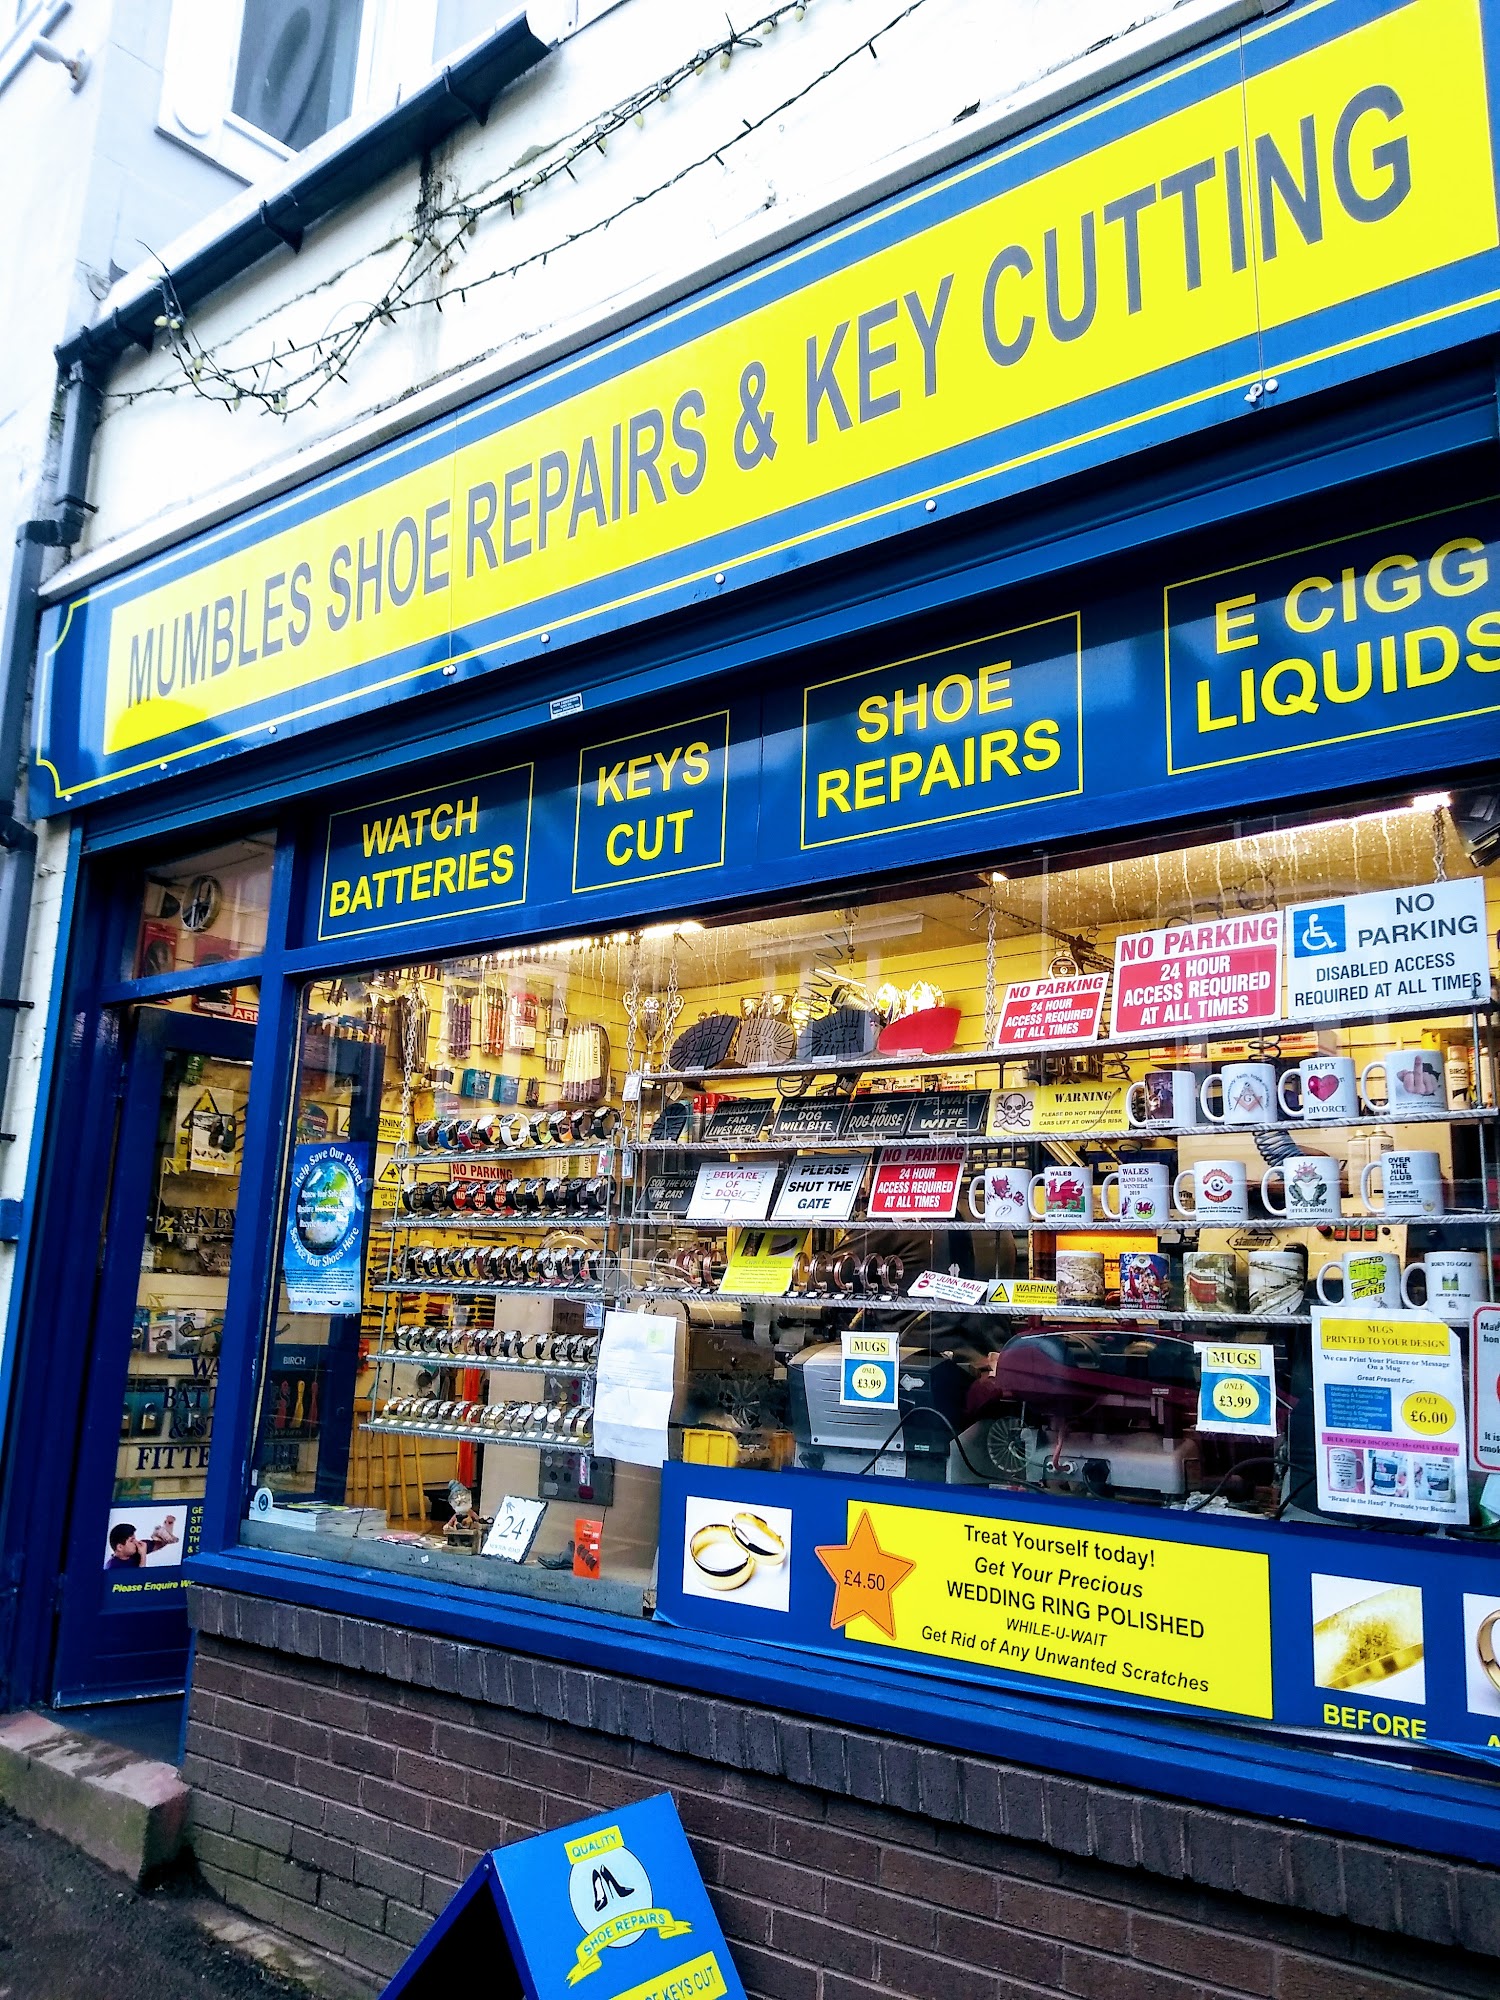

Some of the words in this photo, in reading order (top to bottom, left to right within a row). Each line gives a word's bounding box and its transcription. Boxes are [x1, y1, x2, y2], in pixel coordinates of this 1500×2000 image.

[128, 562, 312, 708] MUMBLES
[327, 500, 451, 633] SHOE
[466, 389, 707, 578] REPAIRS
[734, 361, 778, 471] &
[805, 273, 955, 445] KEY
[982, 84, 1412, 366] CUTTING
[1215, 594, 1259, 654] E
[1284, 538, 1489, 633] CIGG
[1196, 611, 1500, 733] LIQUIDS
[856, 660, 1012, 743] SHOE
[597, 742, 710, 806] KEYS
[817, 720, 1061, 818] REPAIRS
[363, 796, 479, 857] WATCH
[606, 810, 693, 866] CUT
[329, 844, 514, 917] BATTERIES
[1396, 893, 1434, 915] NO
[1120, 938, 1153, 962] NO
[1165, 917, 1278, 957] PARKING
[1358, 915, 1478, 947] PARKING
[1160, 963, 1180, 981] 24
[1186, 956, 1230, 978] HOUR
[1316, 961, 1388, 982] DISABLED
[1394, 952, 1455, 972] ACCESS
[1008, 986, 1030, 999] NO
[1036, 976, 1104, 996] PARKING
[1124, 982, 1182, 1007] ACCESS
[1188, 970, 1270, 1000] REQUIRED
[1295, 986, 1368, 1006] REQUIRED
[1374, 983, 1392, 998] AT
[1398, 979, 1426, 995] ALL
[1432, 972, 1481, 991] TIMES
[1030, 1002, 1042, 1012] 24
[1046, 998, 1072, 1010] HOUR
[1140, 1007, 1160, 1026] AT
[1166, 1003, 1192, 1022] ALL
[1197, 994, 1249, 1018] TIMES
[1006, 1013, 1042, 1026] ACCESS
[1045, 1008, 1094, 1022] REQUIRED
[1014, 1029, 1026, 1039] AT
[1028, 1026, 1046, 1037] ALL
[1049, 1022, 1079, 1035] TIMES
[1308, 1063, 1337, 1071] HAPPY
[1055, 1091, 1112, 1103] WARNING
[798, 1112, 822, 1120] DOG
[1308, 1106, 1347, 1114] DIVORCE
[726, 1116, 748, 1124] FAN
[780, 1122, 805, 1131] WILL
[807, 1121, 833, 1130] BITE
[872, 1114, 904, 1126] HOUSE
[920, 1118, 968, 1129] WIFE
[709, 1126, 731, 1135] LIVES
[734, 1124, 757, 1134] HERE
[882, 1149, 900, 1162] NO
[905, 1146, 964, 1161] PARKING
[294, 1164, 310, 1188] Help
[309, 1150, 327, 1165] Save
[329, 1147, 344, 1160] Our
[344, 1154, 363, 1186] Planet
[452, 1164, 467, 1176] NO
[470, 1166, 513, 1180] PARKING
[713, 1171, 759, 1179] BEWARE
[801, 1164, 850, 1176] PLEASE
[899, 1169, 910, 1180] 24
[912, 1168, 936, 1179] HOUR
[651, 1190, 664, 1198] THE
[665, 1190, 684, 1198] CATS
[788, 1181, 823, 1192] SHUT
[828, 1181, 853, 1192] THE
[877, 1181, 910, 1194] ACCESS
[912, 1181, 953, 1193] REQUIRED
[655, 1201, 670, 1209] EVIL
[797, 1198, 832, 1209] GATE
[884, 1195, 896, 1208] AT
[898, 1195, 912, 1207] ALL
[914, 1195, 940, 1207] TIMES
[290, 1227, 306, 1259] Service
[306, 1255, 321, 1267] Your
[322, 1249, 344, 1267] Shoes
[342, 1227, 359, 1251] Here
[1233, 1235, 1273, 1247] standard
[923, 1272, 936, 1280] NO
[936, 1276, 958, 1286] JUNK
[961, 1282, 982, 1293] MAIL
[853, 1340, 887, 1353] MUGS
[1326, 1335, 1365, 1344] PRINTED
[1380, 1337, 1408, 1346] YOUR
[1410, 1339, 1444, 1348] DESIGN
[283, 1356, 306, 1365] BIRCH
[1212, 1351, 1258, 1367] MUGS
[1421, 1360, 1450, 1368] Message
[857, 1378, 882, 1389] £3.99
[1222, 1382, 1245, 1391] ONLY
[1218, 1394, 1252, 1410] £3.99
[1416, 1396, 1438, 1405] ONLY
[1410, 1410, 1448, 1425] £6.00
[499, 1516, 525, 1540] 24
[963, 1525, 1008, 1547] Treat
[1012, 1532, 1088, 1558] Yourself
[1094, 1544, 1155, 1570] today!
[112, 1582, 142, 1592] Please
[144, 1581, 178, 1591] Enquire
[843, 1569, 886, 1592] £4.50
[974, 1557, 1004, 1577] Get
[1010, 1562, 1053, 1584] Your
[1058, 1568, 1144, 1599] Precious
[946, 1580, 1035, 1611] WEDDING
[1042, 1596, 1091, 1620] RING
[1097, 1605, 1205, 1639] POLISHED
[1005, 1618, 1108, 1648] WHILE-U-WAIT
[921, 1625, 948, 1643] Get
[950, 1630, 976, 1649] Rid
[979, 1637, 996, 1652] of
[999, 1640, 1030, 1662] Any
[1034, 1646, 1117, 1676] Unwanted
[1121, 1662, 1210, 1693] Scratches
[1323, 1703, 1427, 1740] BEFORE
[571, 1833, 617, 1858] QUALITY
[583, 1927, 613, 1956] SHOE
[616, 1913, 666, 1932] REPAIRS
[662, 1978, 693, 2000] KEYS
[694, 1966, 715, 1990] CUT
